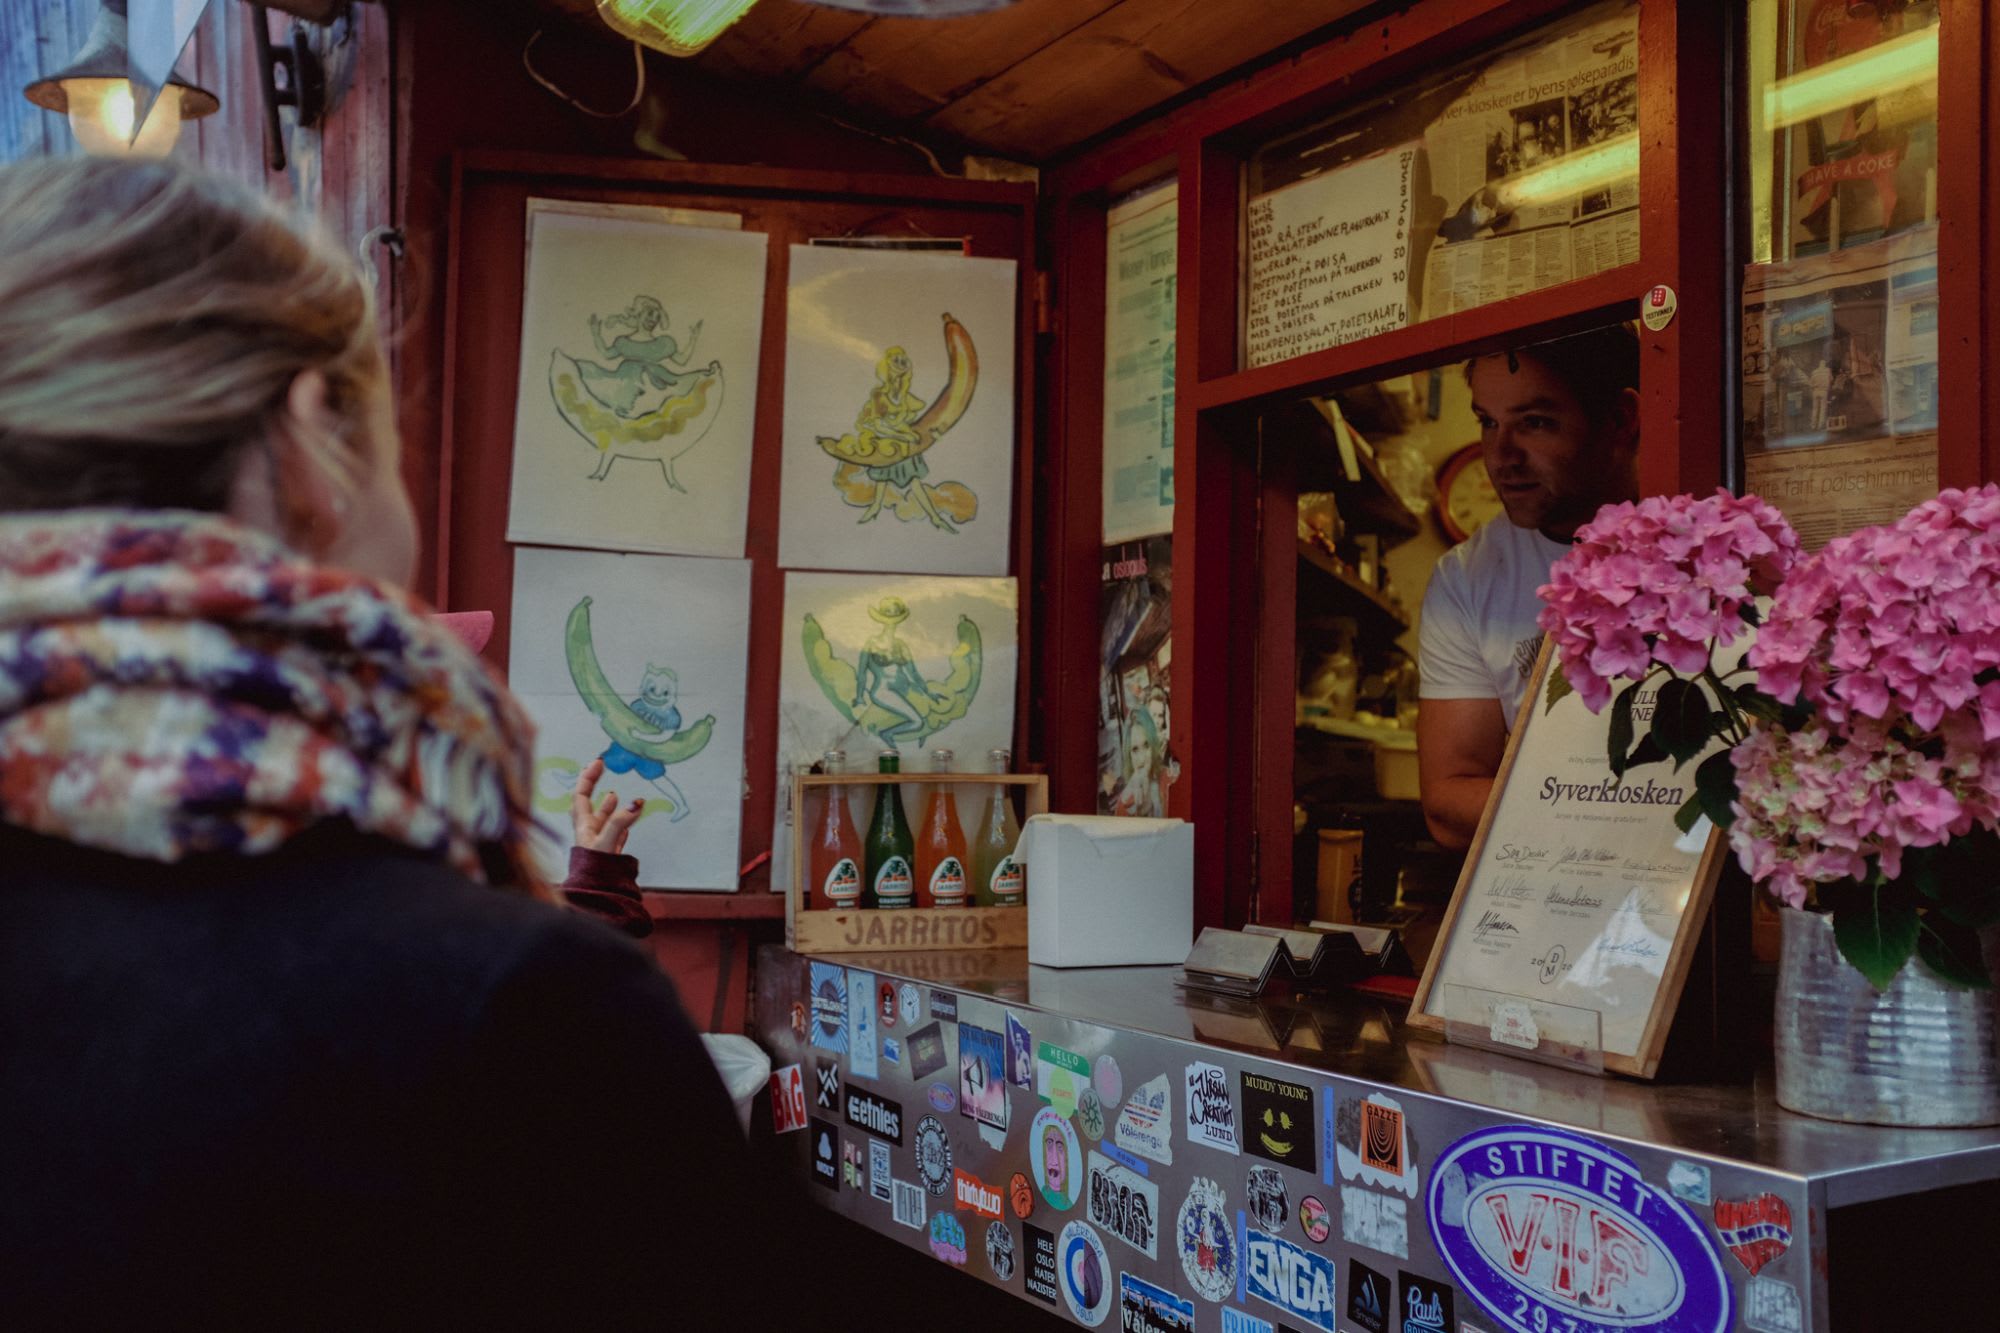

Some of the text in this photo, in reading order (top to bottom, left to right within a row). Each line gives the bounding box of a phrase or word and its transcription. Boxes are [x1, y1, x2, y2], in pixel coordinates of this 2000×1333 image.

[1856, 155, 1897, 174] COKE
[844, 914, 998, 945] JARRITOS
[1050, 1047, 1079, 1066] HELLO
[1245, 1076, 1309, 1101] MUDDY YOUNG
[1366, 1105, 1399, 1122] GAZZE
[1204, 1124, 1234, 1142] LUND
[1487, 1143, 1652, 1217] STIFTET
[1037, 1237, 1054, 1254] HELE
[1035, 1252, 1056, 1270] OSLO
[1034, 1266, 1056, 1285] HATER
[1249, 1241, 1333, 1312] ENGA
[1027, 1278, 1057, 1301] NAZISTER
